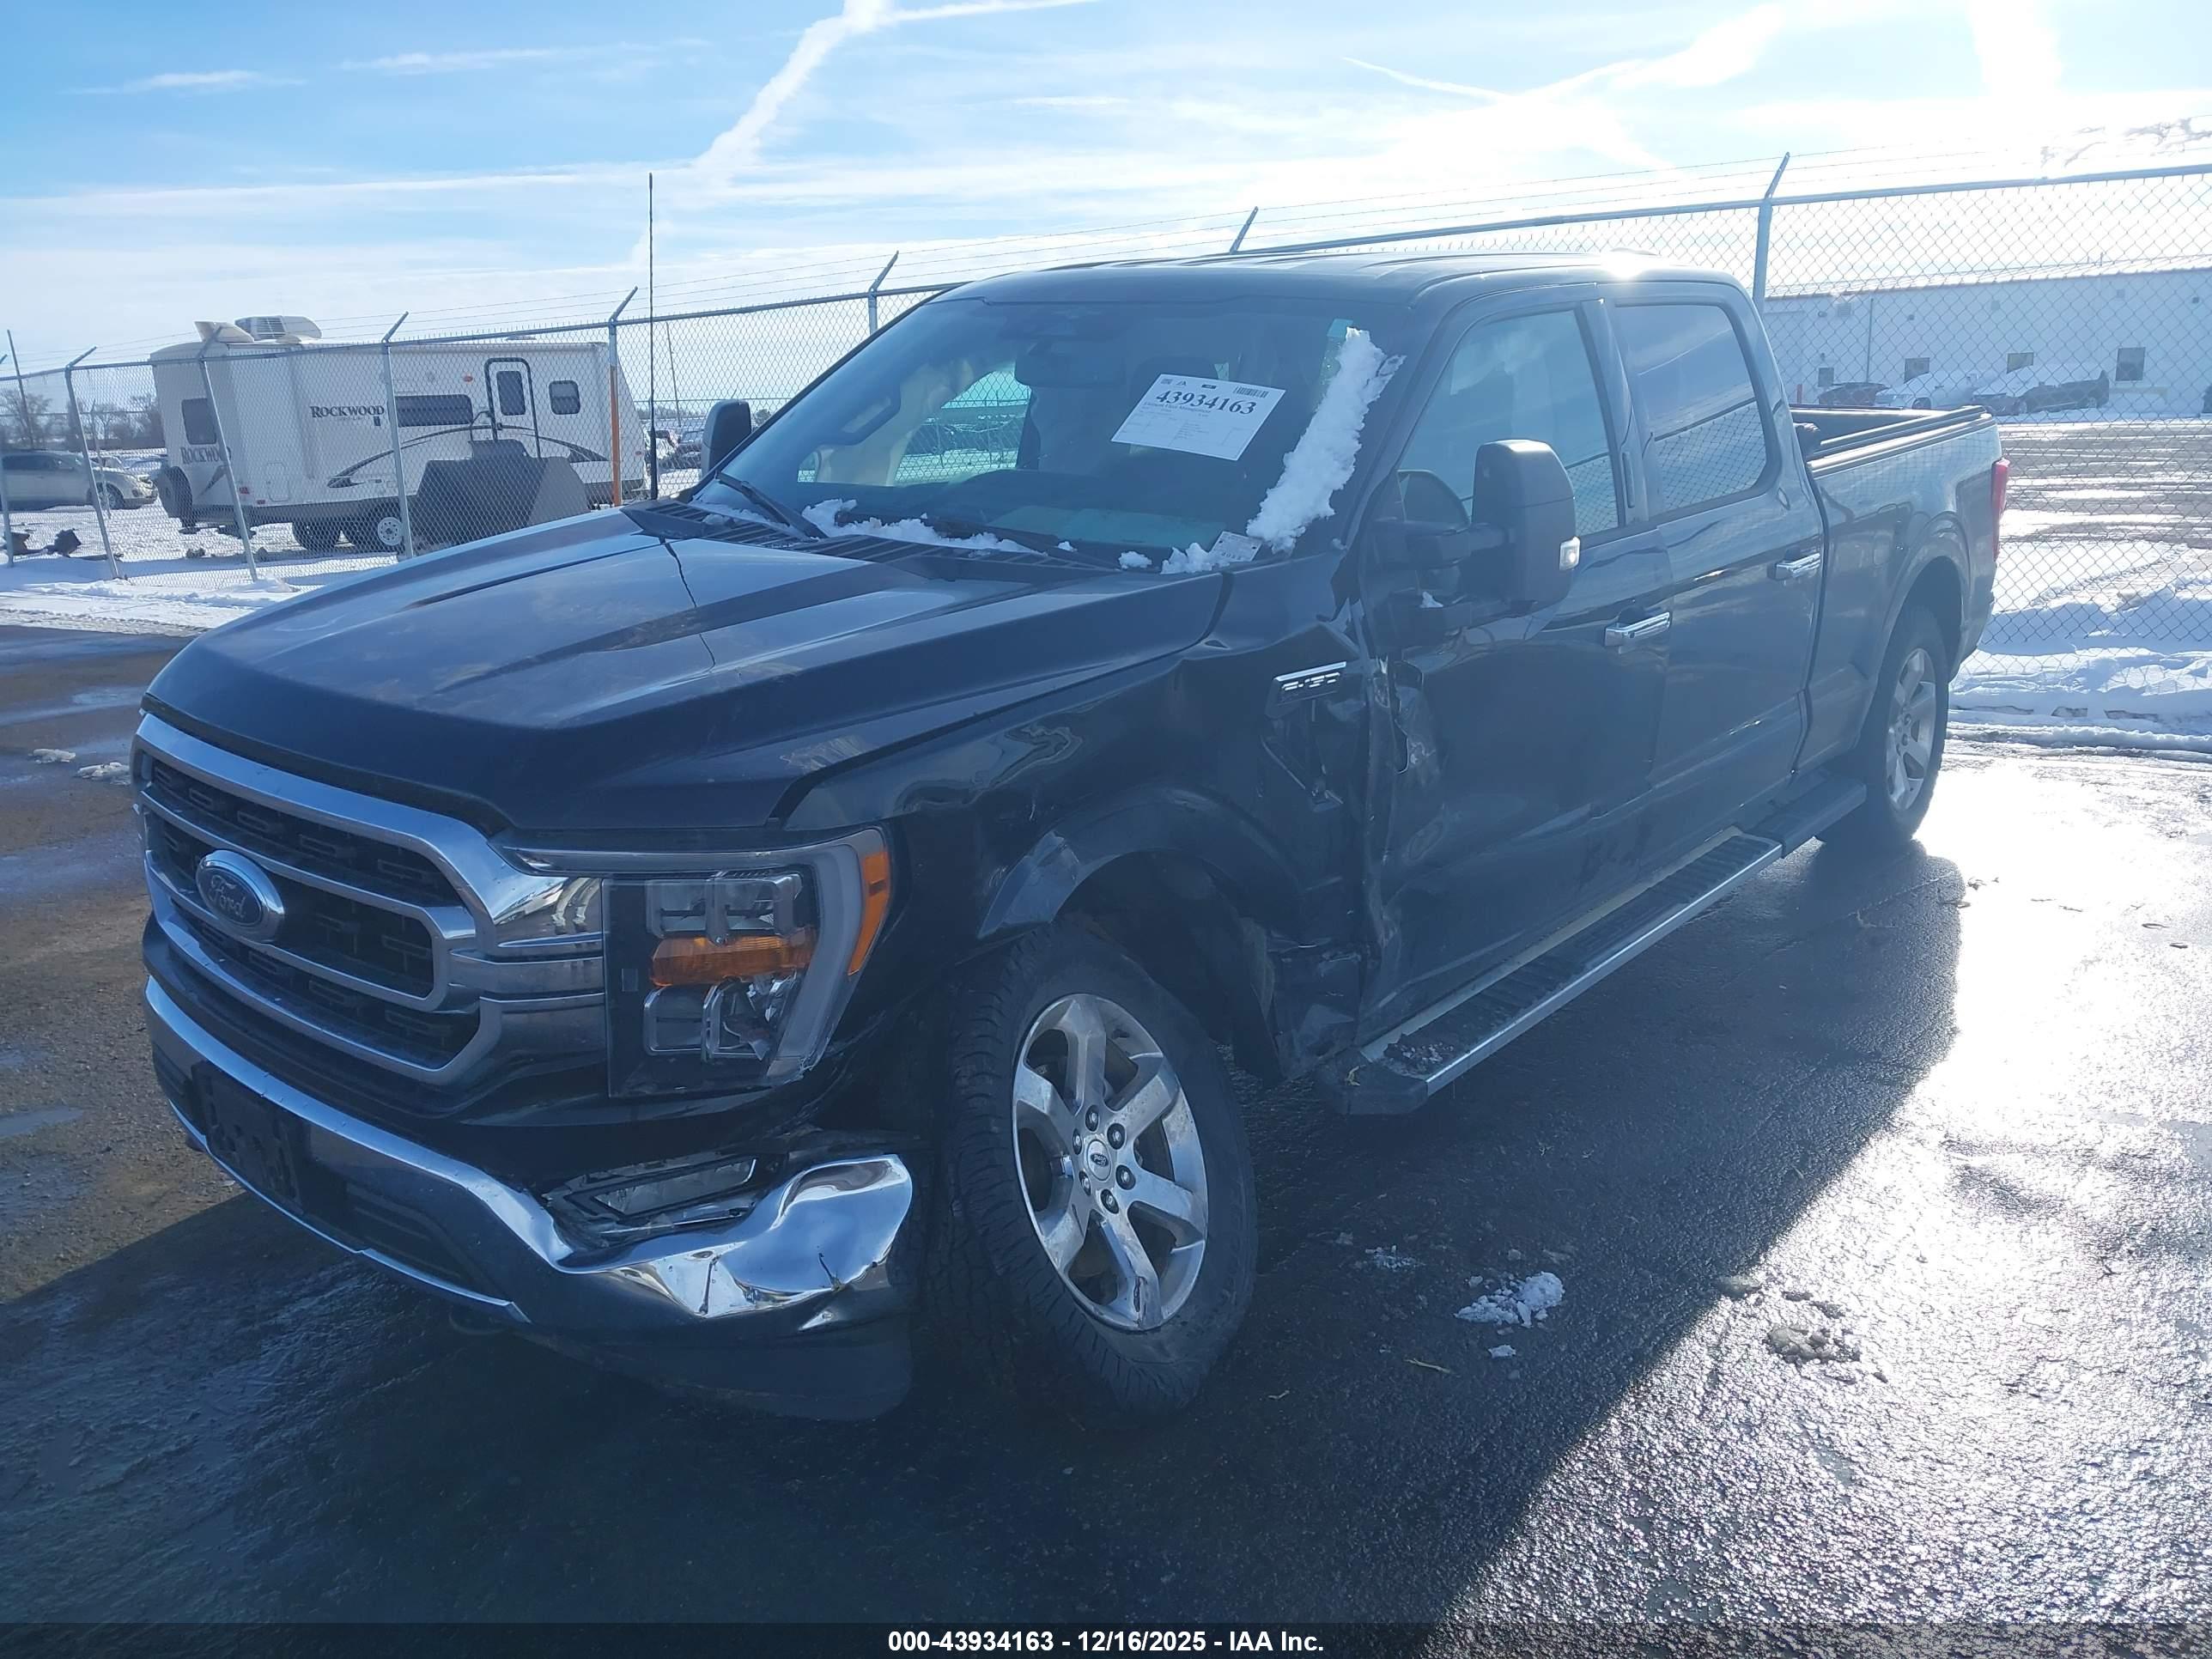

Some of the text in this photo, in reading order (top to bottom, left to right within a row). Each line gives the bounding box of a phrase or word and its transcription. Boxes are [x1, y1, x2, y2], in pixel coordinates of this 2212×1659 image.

[310, 405, 385, 418] ROCKWOOD
[1156, 390, 1257, 415] 43934163
[180, 447, 232, 465] ROCKWOD
[1281, 672, 1340, 691] F-150
[210, 874, 247, 920] Ford
